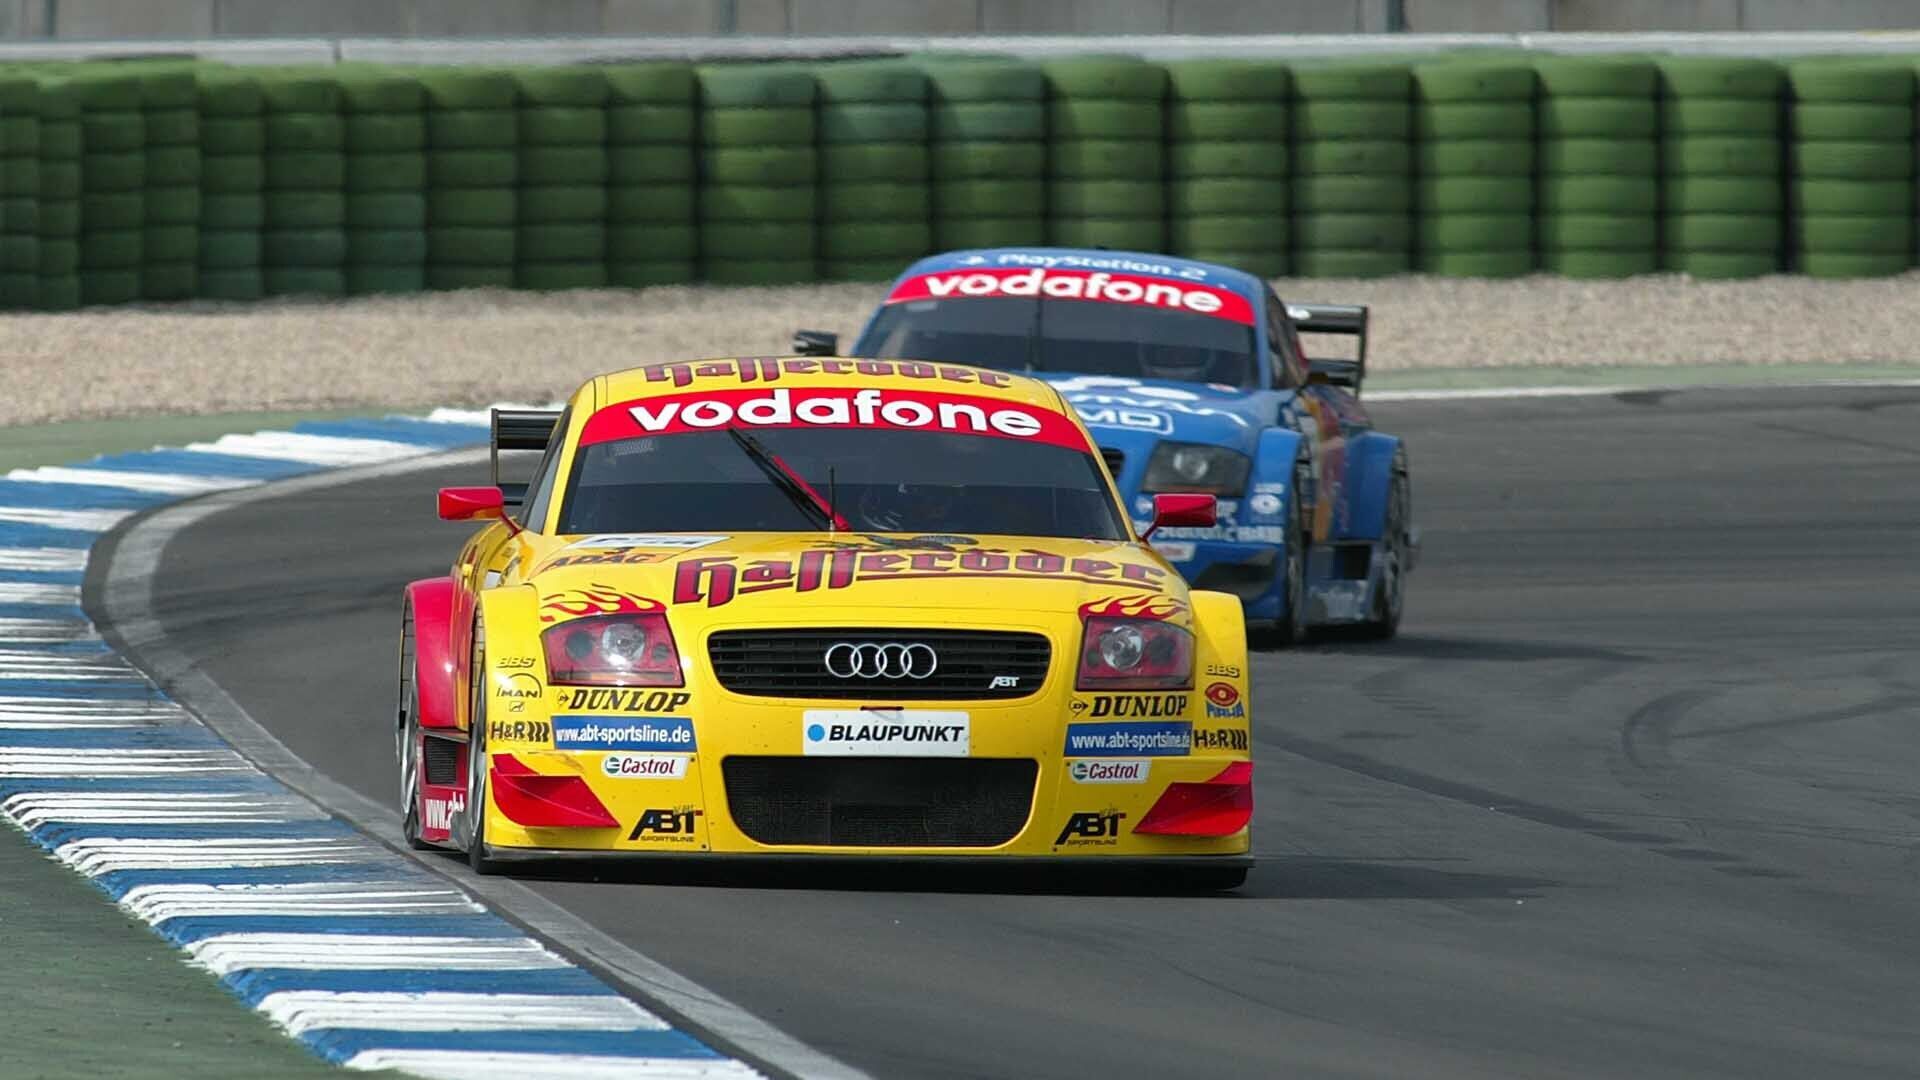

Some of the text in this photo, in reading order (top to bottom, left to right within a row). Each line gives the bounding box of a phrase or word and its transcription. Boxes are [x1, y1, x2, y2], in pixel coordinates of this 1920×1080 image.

[926, 269, 1223, 313] vodafone
[629, 388, 1042, 436] vodafone
[1077, 408, 1162, 428] MD
[988, 675, 1021, 689] ABT
[1206, 664, 1241, 679] BBS
[501, 689, 539, 698] MAN
[569, 688, 691, 713] DUNLOP
[1090, 694, 1188, 718] DUNLOP
[491, 720, 526, 741] H&R
[555, 724, 692, 745] www.abt-sportsline.de
[828, 725, 965, 743] BLAUPUNKT
[1071, 730, 1191, 752] www.abt-sportsline.de
[1194, 728, 1230, 749] H&R
[621, 757, 676, 775] Castrol
[1089, 762, 1140, 780] Castrol
[627, 808, 704, 841] ABT
[1055, 812, 1127, 846] ABT
